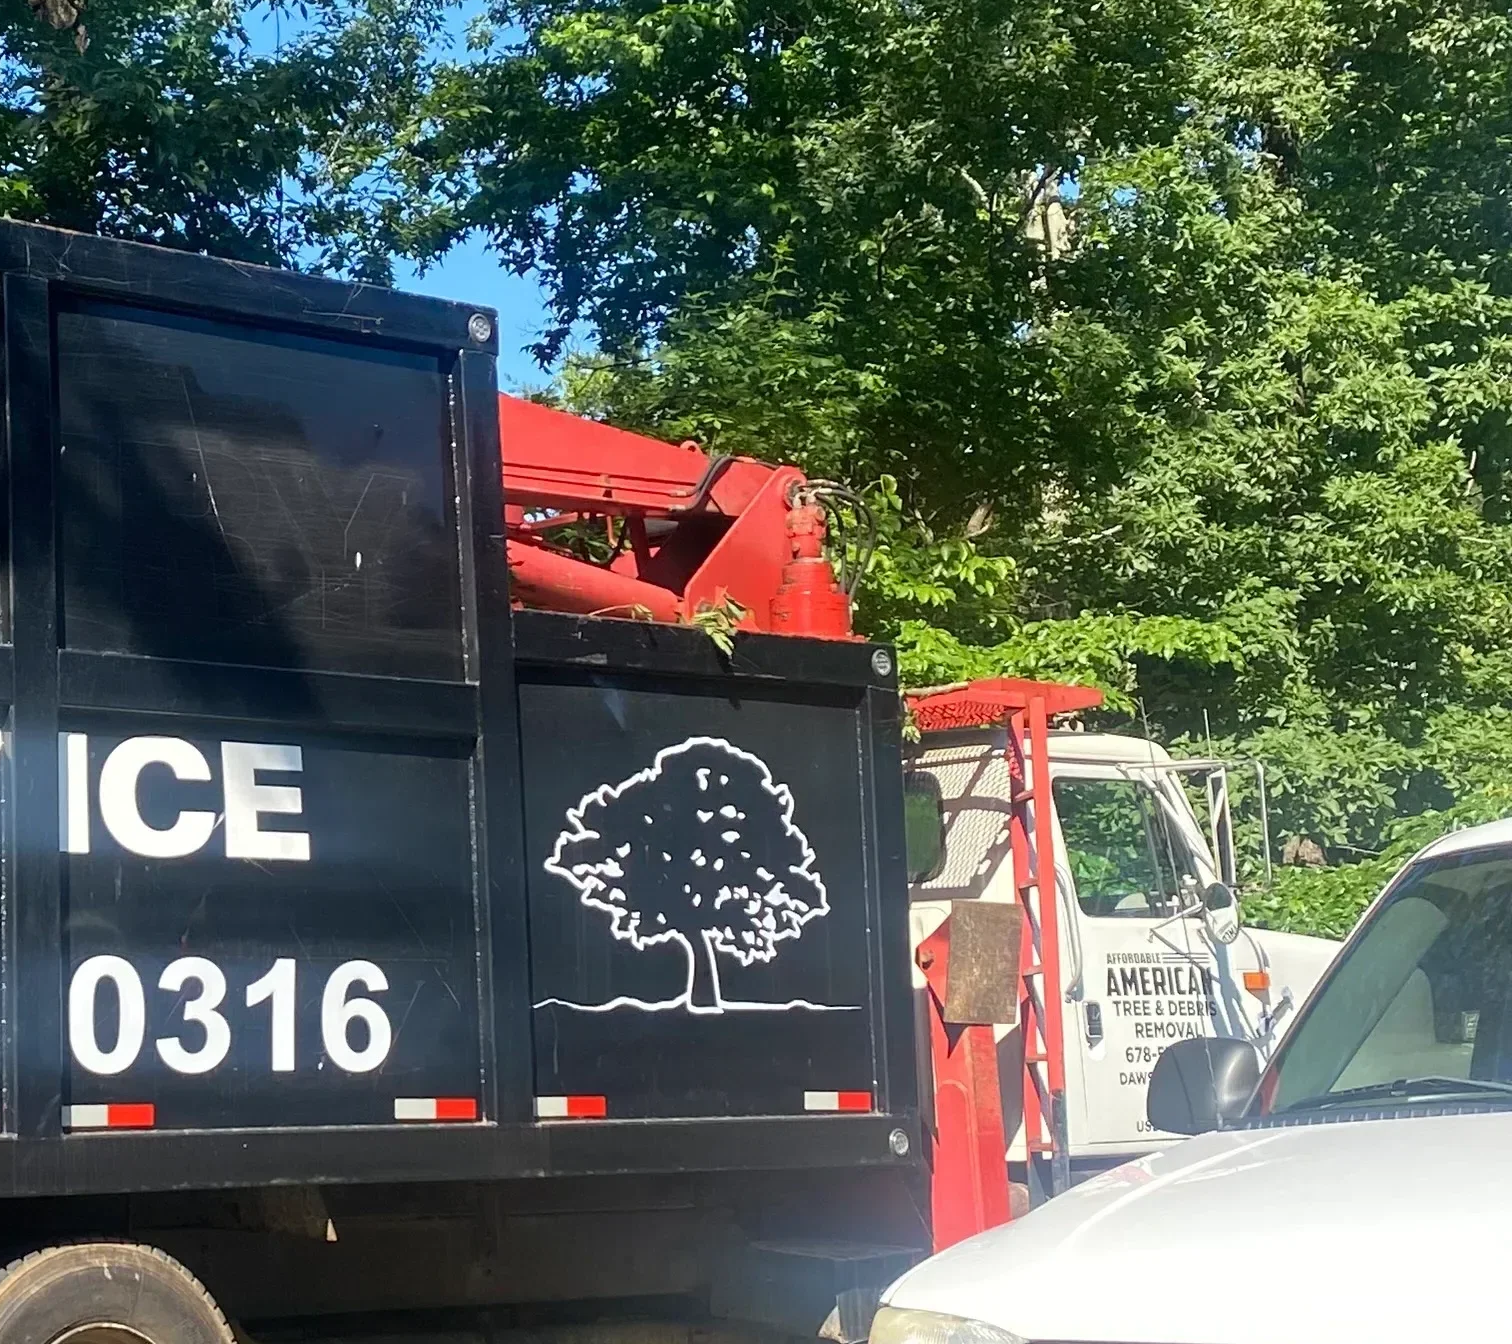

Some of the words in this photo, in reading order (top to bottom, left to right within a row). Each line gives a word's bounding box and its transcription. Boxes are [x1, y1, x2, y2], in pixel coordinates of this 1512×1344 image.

[1107, 952, 1161, 964] AFFORDABLE
[1107, 966, 1214, 996] AMERICAN
[1112, 1000, 1152, 1017] TREE
[1155, 1000, 1164, 1016] &
[1168, 1000, 1217, 1017] DEBRIS
[1134, 1022, 1203, 1038] REMOVAL
